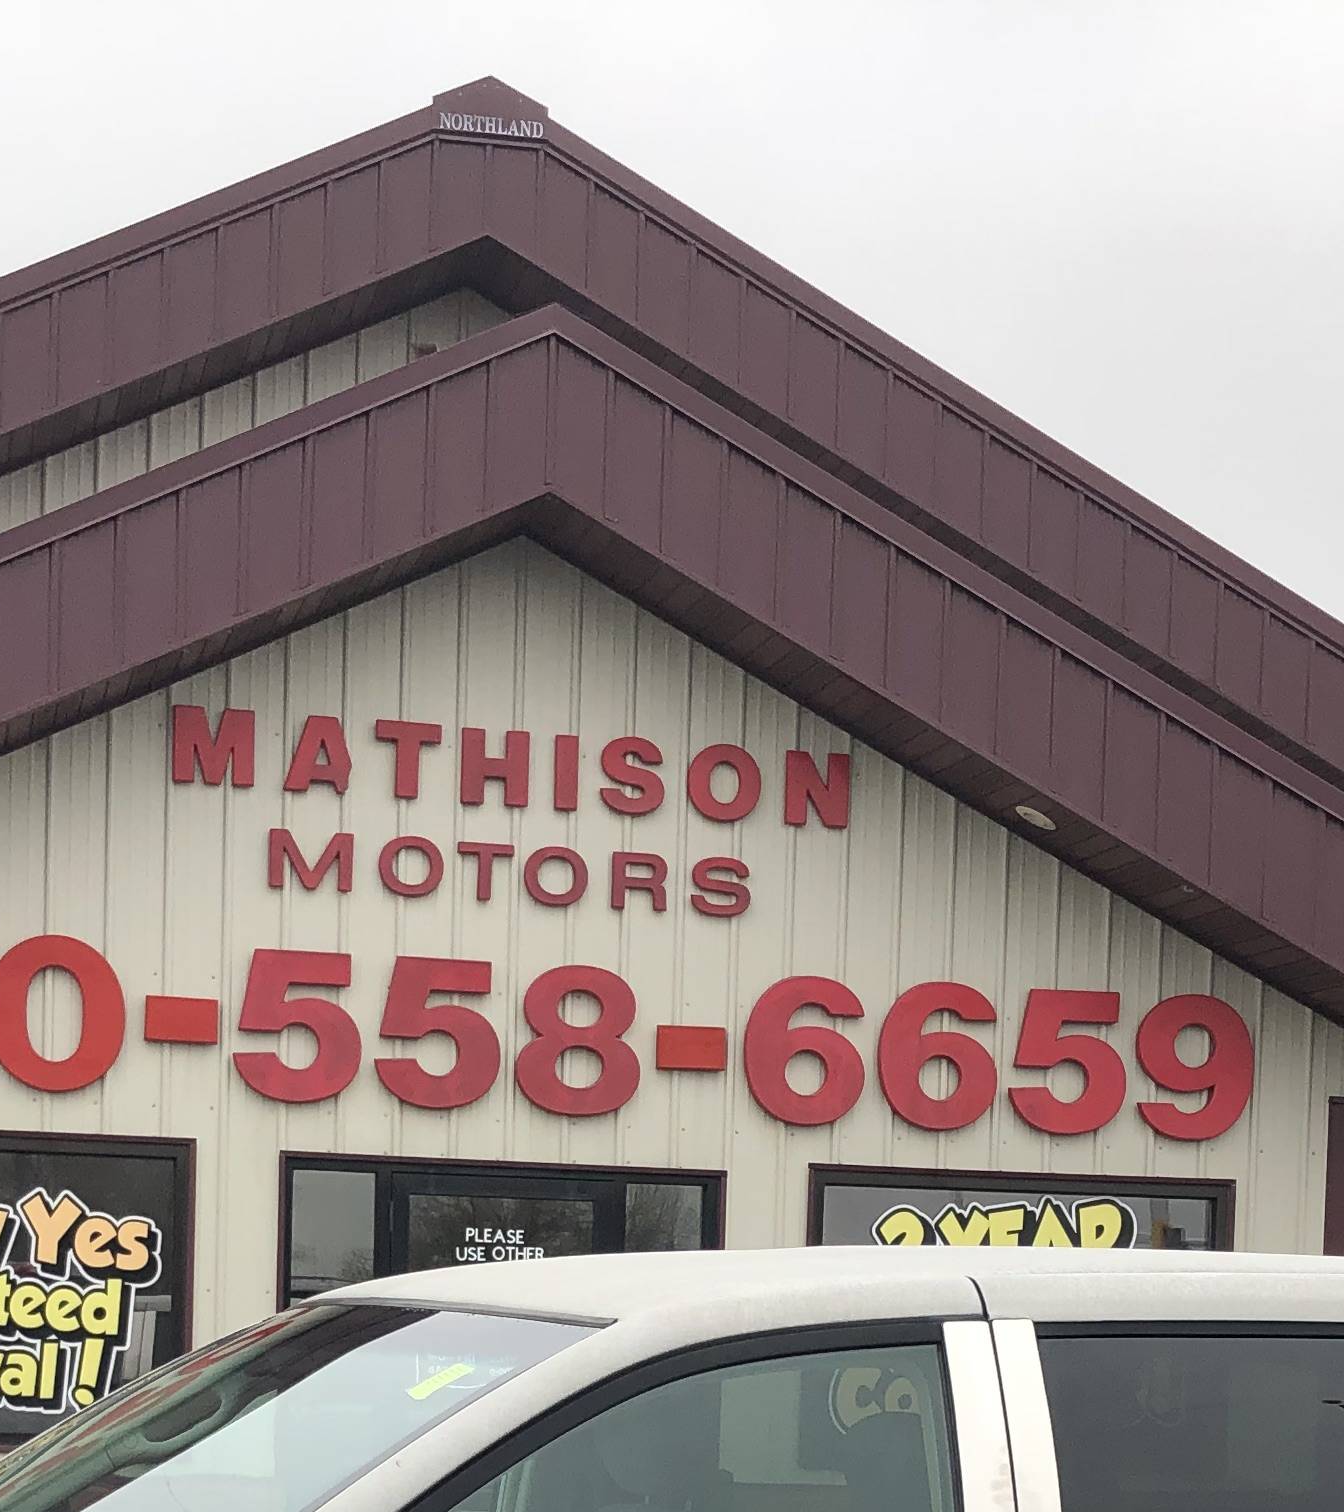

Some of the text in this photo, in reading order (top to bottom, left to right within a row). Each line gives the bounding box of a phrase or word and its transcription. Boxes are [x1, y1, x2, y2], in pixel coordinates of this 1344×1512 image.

[439, 112, 544, 138] NORTHLAND
[171, 704, 851, 829] MATHISON
[268, 828, 751, 917] MOTORS
[23, 1193, 151, 1272] Yes
[456, 1246, 544, 1261] USE OTHER
[465, 1227, 525, 1245] PLEASE
